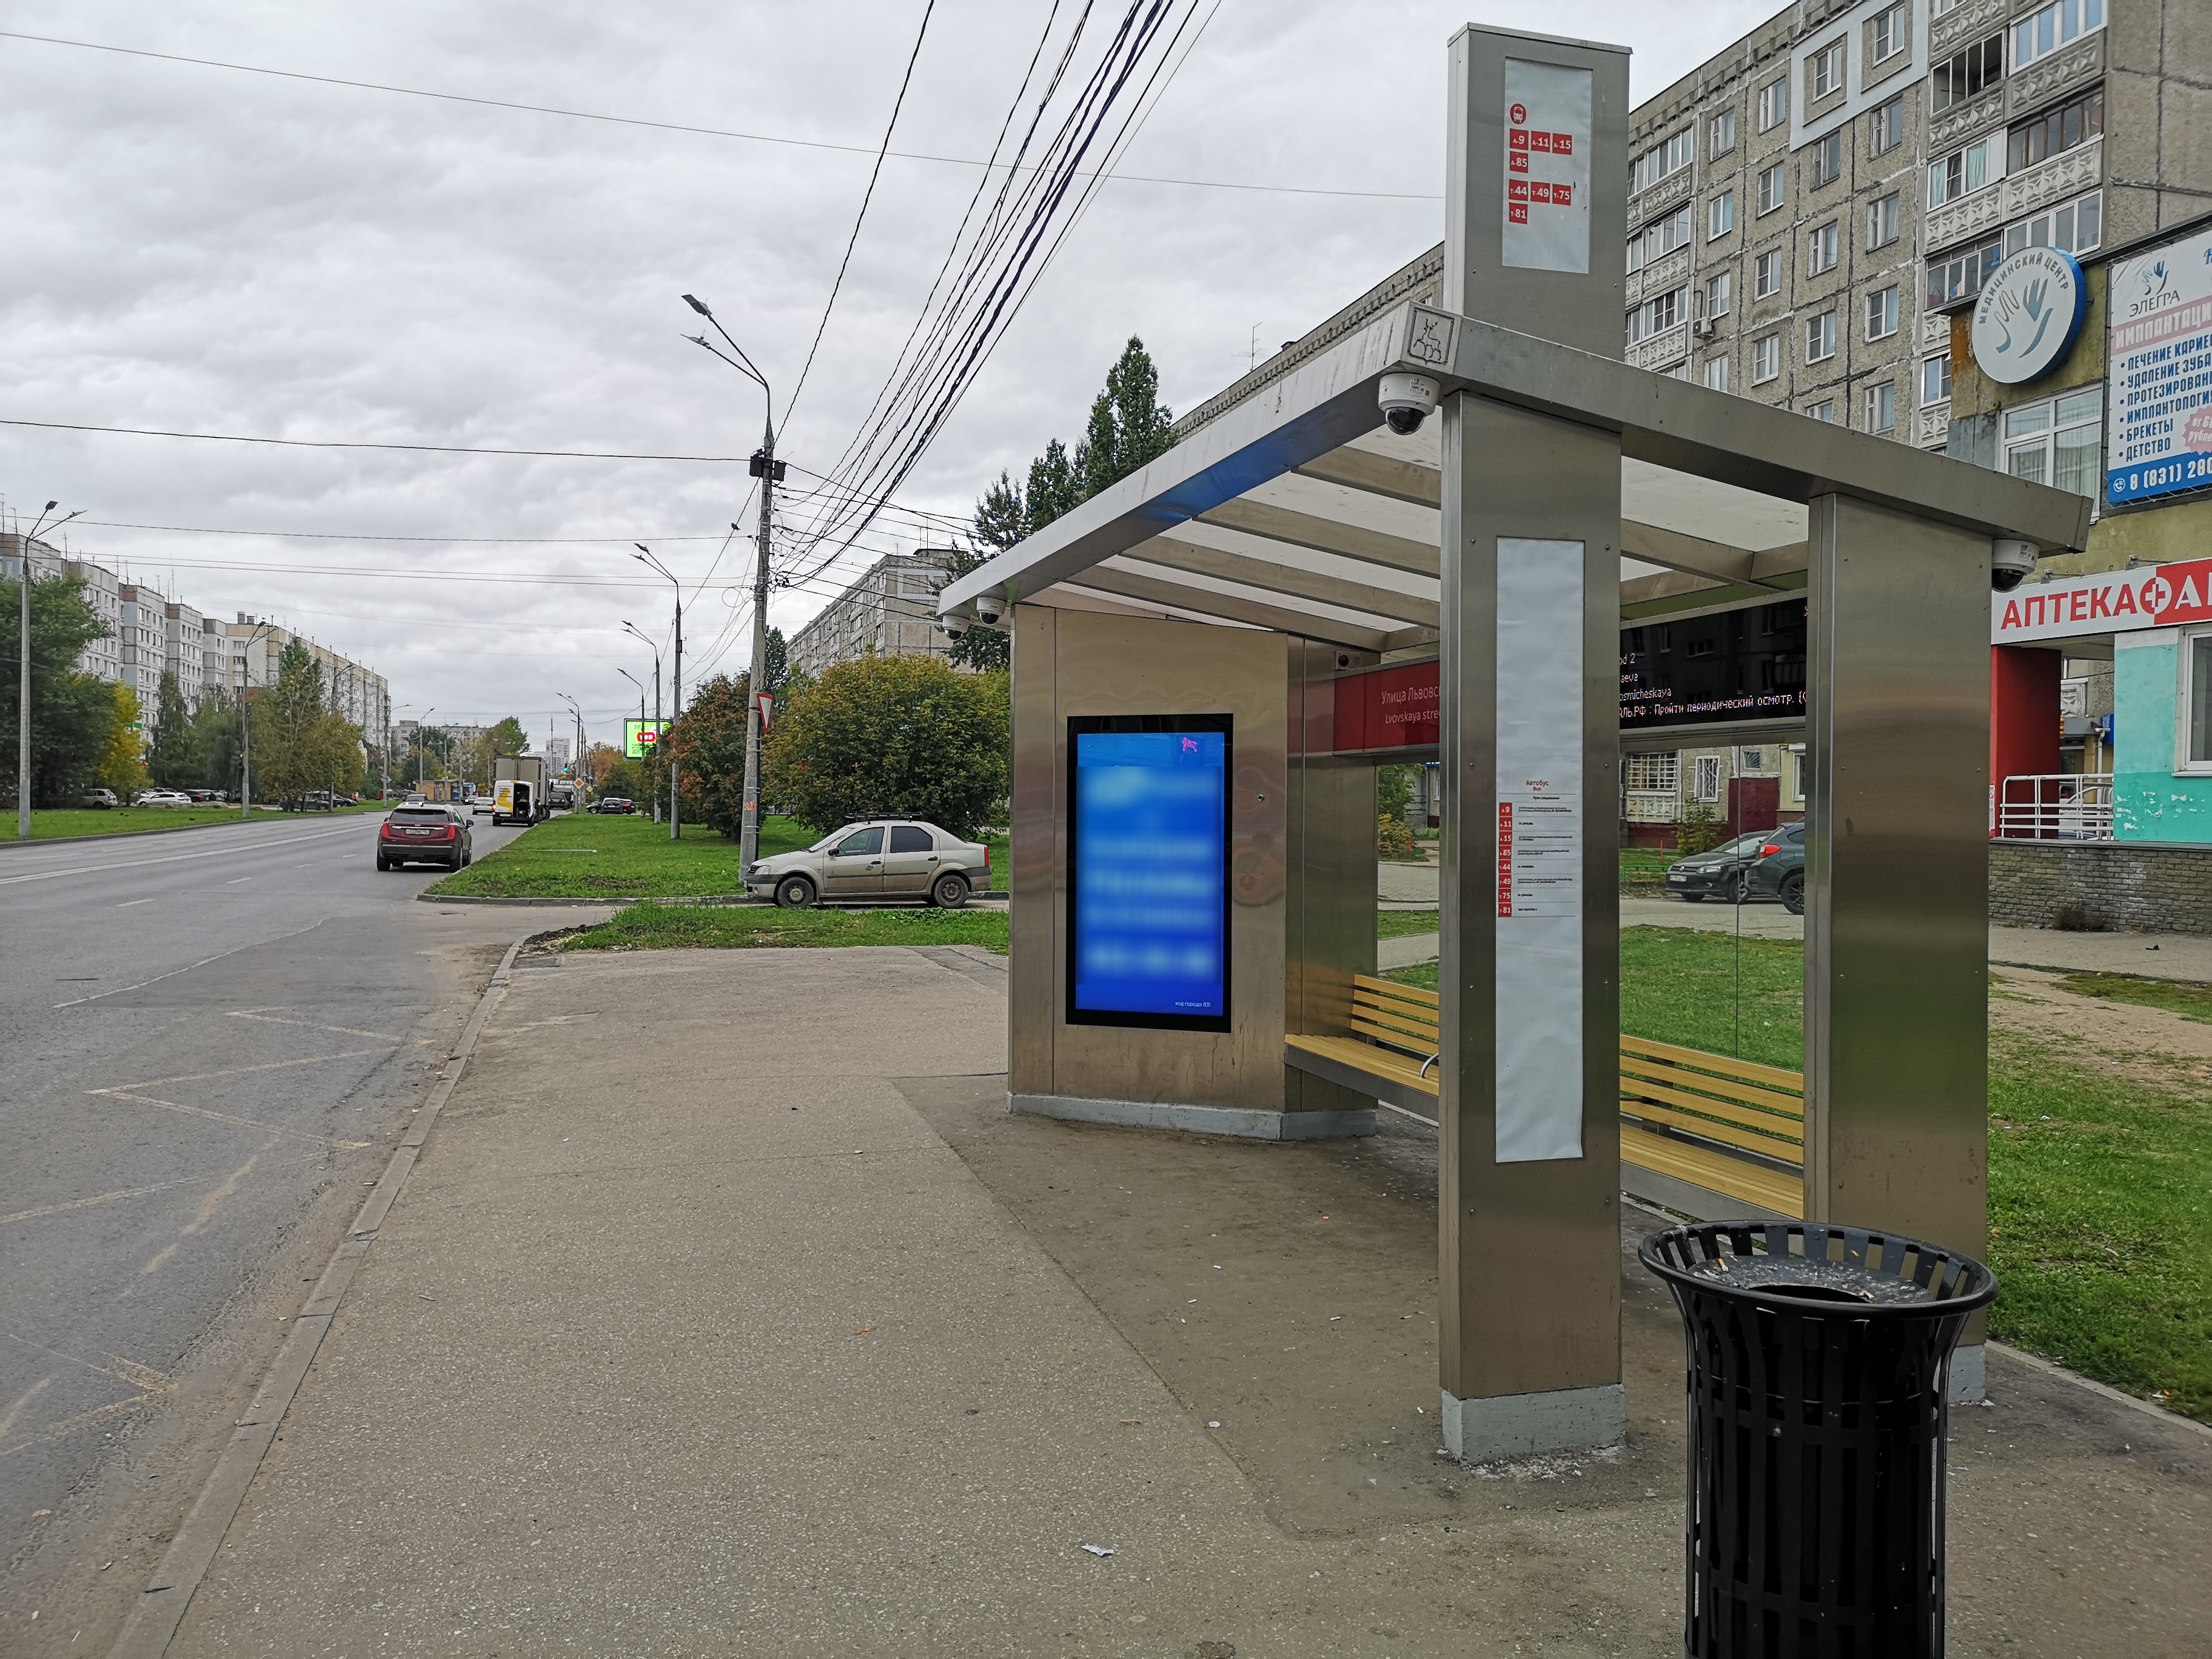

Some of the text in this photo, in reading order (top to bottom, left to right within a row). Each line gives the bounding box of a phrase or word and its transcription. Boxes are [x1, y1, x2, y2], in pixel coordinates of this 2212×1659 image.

[1979, 252, 2069, 324] МЕДИЦИНСКИЙ ЦЕНТР
[2129, 289, 2180, 318] ЭЛЕГРА
[2128, 346, 2172, 371] ЛЕЧЕНИЕ
[2127, 361, 2180, 389] УДАЛЕНИЕ
[2127, 389, 2212, 424] ИМПЛАНТОЛОГИ
[2127, 418, 2173, 442] БРЕКЕТЫ
[2126, 437, 2171, 462] ДЕТСТВО
[2130, 473, 2139, 491] 8
[2143, 463, 2182, 489] (831)
[2000, 583, 2137, 630] АПТЕКА
[1629, 652, 1635, 664] 2
[1381, 686, 1440, 705] Улица Львовс
[1654, 702, 1684, 716] Пройти
[1687, 695, 1754, 713] периодический
[1385, 709, 1440, 724] Lvovskaya stre
